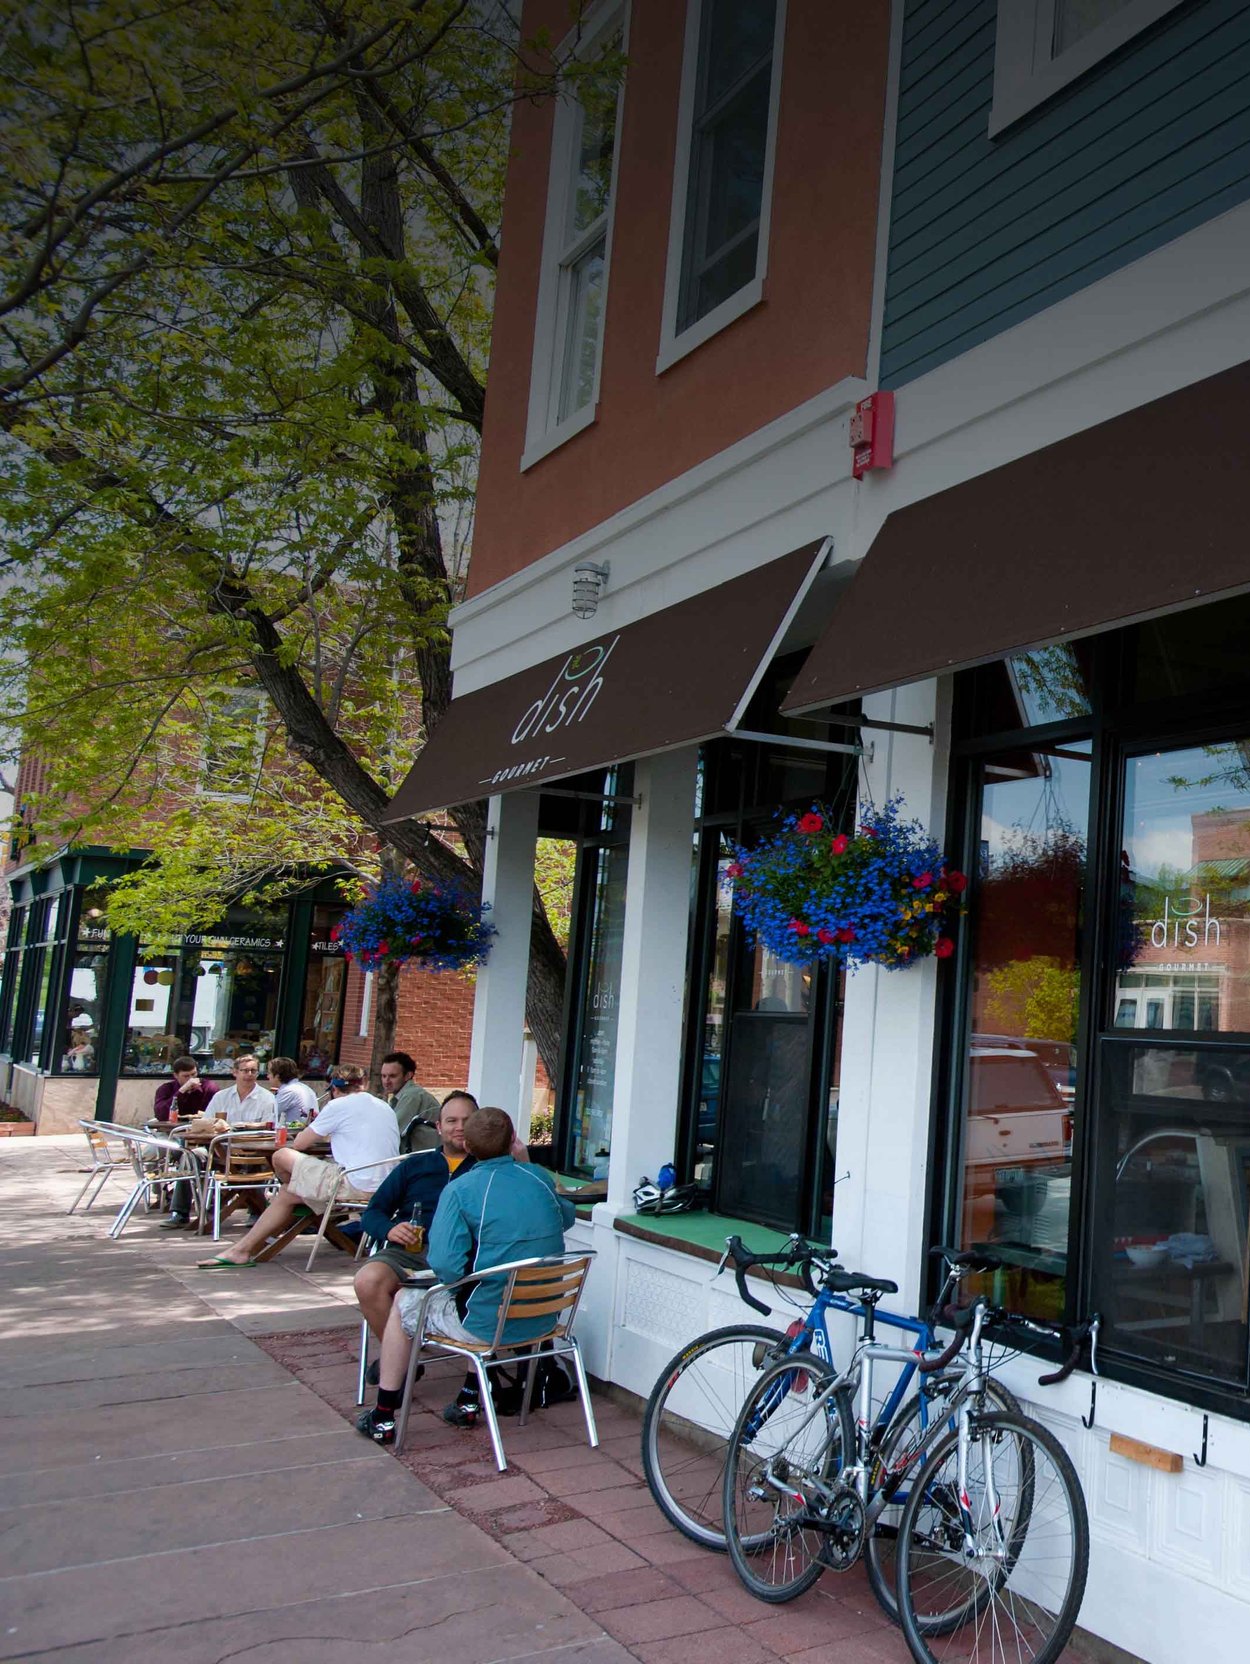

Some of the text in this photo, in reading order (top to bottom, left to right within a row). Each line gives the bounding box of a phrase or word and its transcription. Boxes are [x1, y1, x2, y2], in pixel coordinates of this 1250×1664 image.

[511, 634, 620, 744] dish
[491, 756, 550, 784] GOURMET
[1151, 893, 1221, 948] dish
[229, 936, 271, 947] CERAMICS
[1159, 963, 1208, 972] GOURMET
[592, 982, 615, 1009] dish
